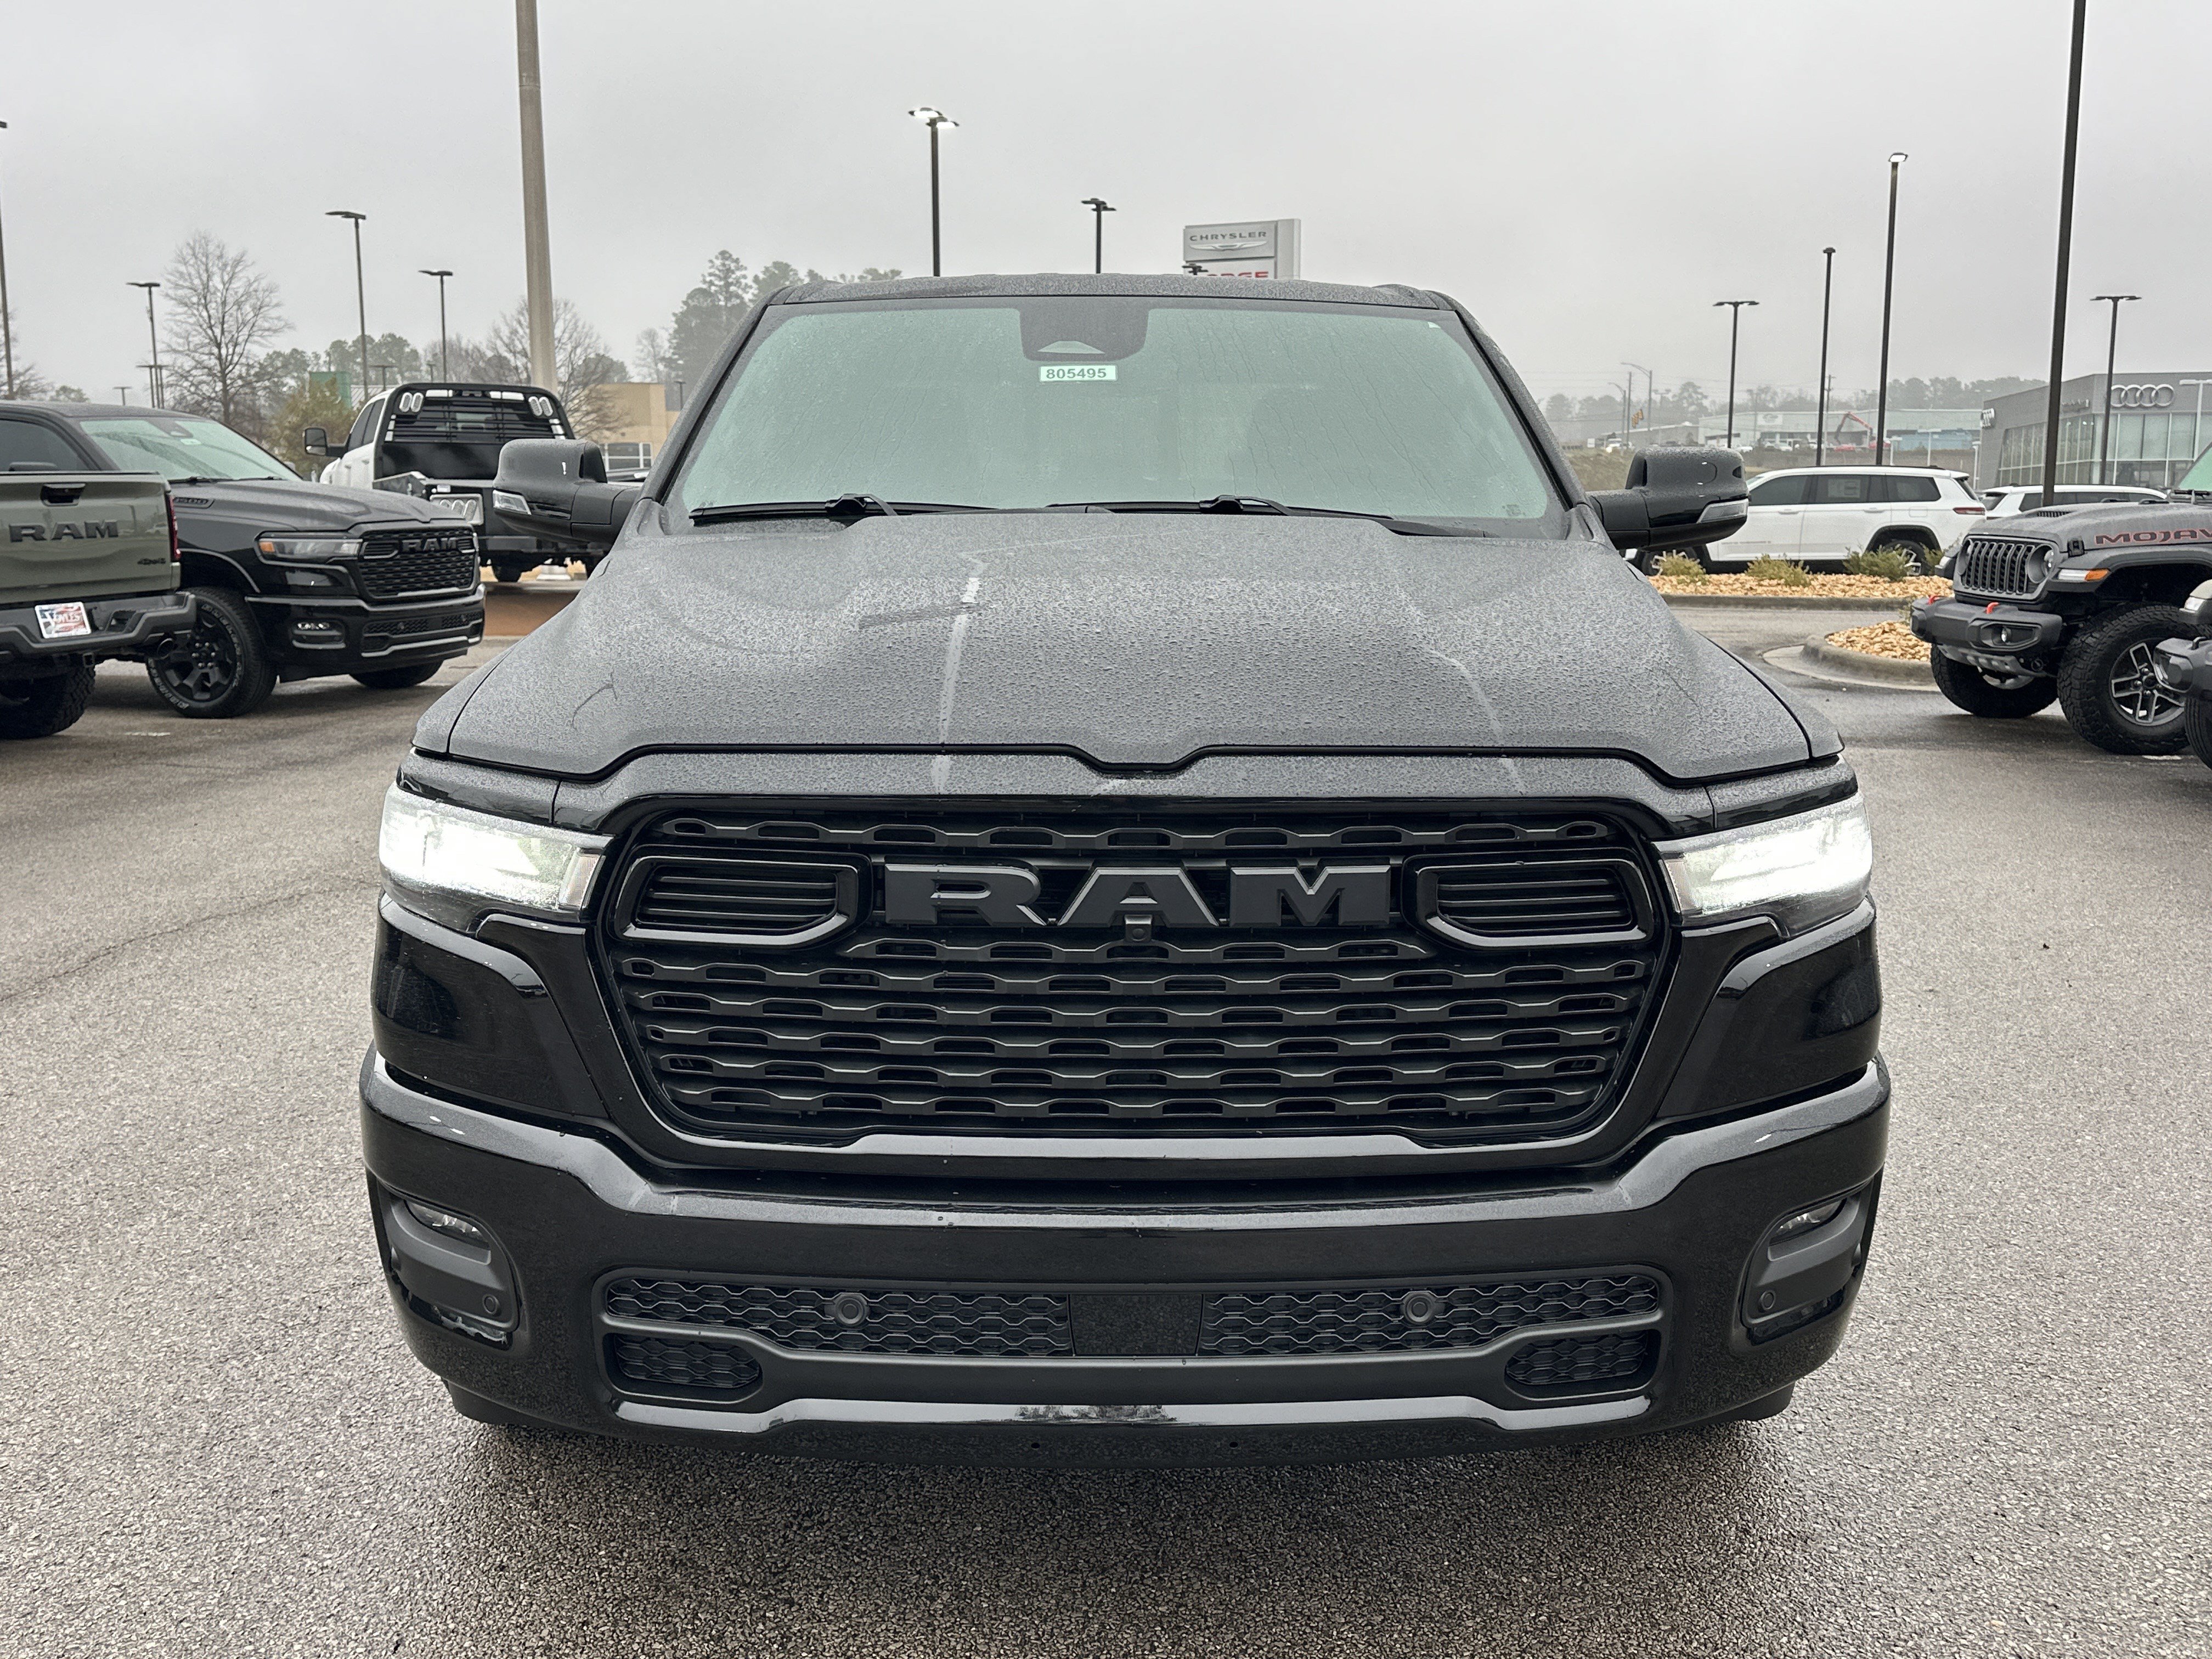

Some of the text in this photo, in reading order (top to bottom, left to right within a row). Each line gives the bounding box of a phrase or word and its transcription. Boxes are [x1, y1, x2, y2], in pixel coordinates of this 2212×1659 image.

[1189, 231, 1267, 242] CHRYSLER
[1046, 368, 1107, 379] 805495
[9, 519, 119, 543] RAM
[402, 537, 458, 552] RAM
[884, 859, 1392, 927] RAM
